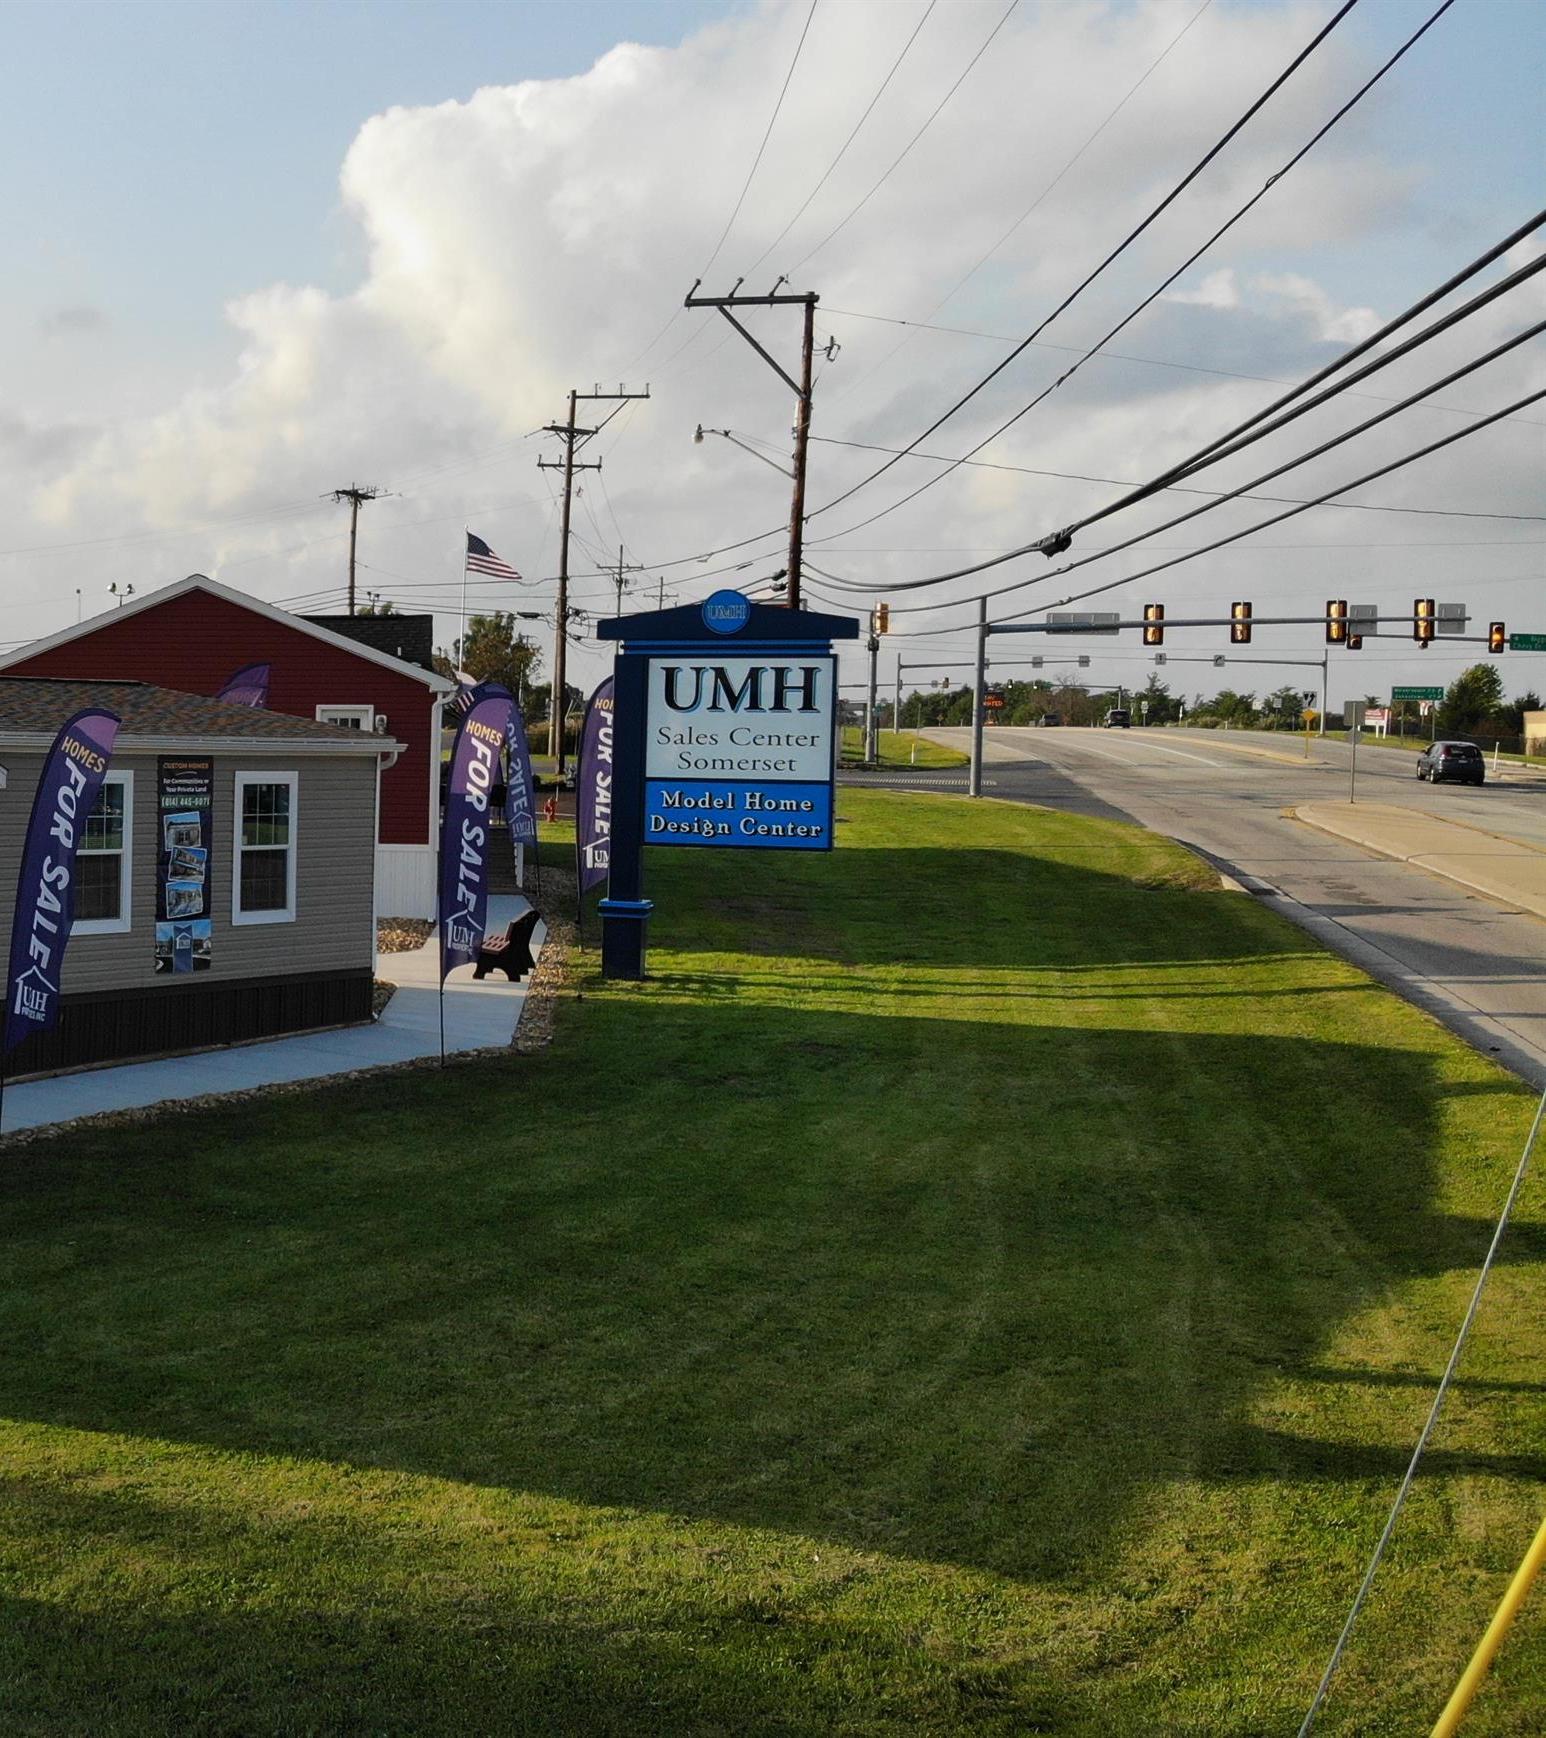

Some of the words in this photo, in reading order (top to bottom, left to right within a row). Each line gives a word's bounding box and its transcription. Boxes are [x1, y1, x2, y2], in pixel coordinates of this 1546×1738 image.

[707, 604, 746, 619] UMH
[661, 666, 822, 713] UMH
[466, 719, 502, 747] HOMES
[657, 726, 719, 746] Sales
[729, 727, 820, 747] Center
[61, 735, 105, 774] HOMES
[677, 751, 797, 772] Somerset
[466, 738, 492, 812] FOR
[50, 757, 87, 849] FOR
[660, 790, 734, 811] Model
[744, 792, 814, 812] Home
[650, 815, 730, 836] Design
[739, 817, 823, 837] Center
[457, 818, 485, 912] SALE
[29, 855, 71, 970] SALE
